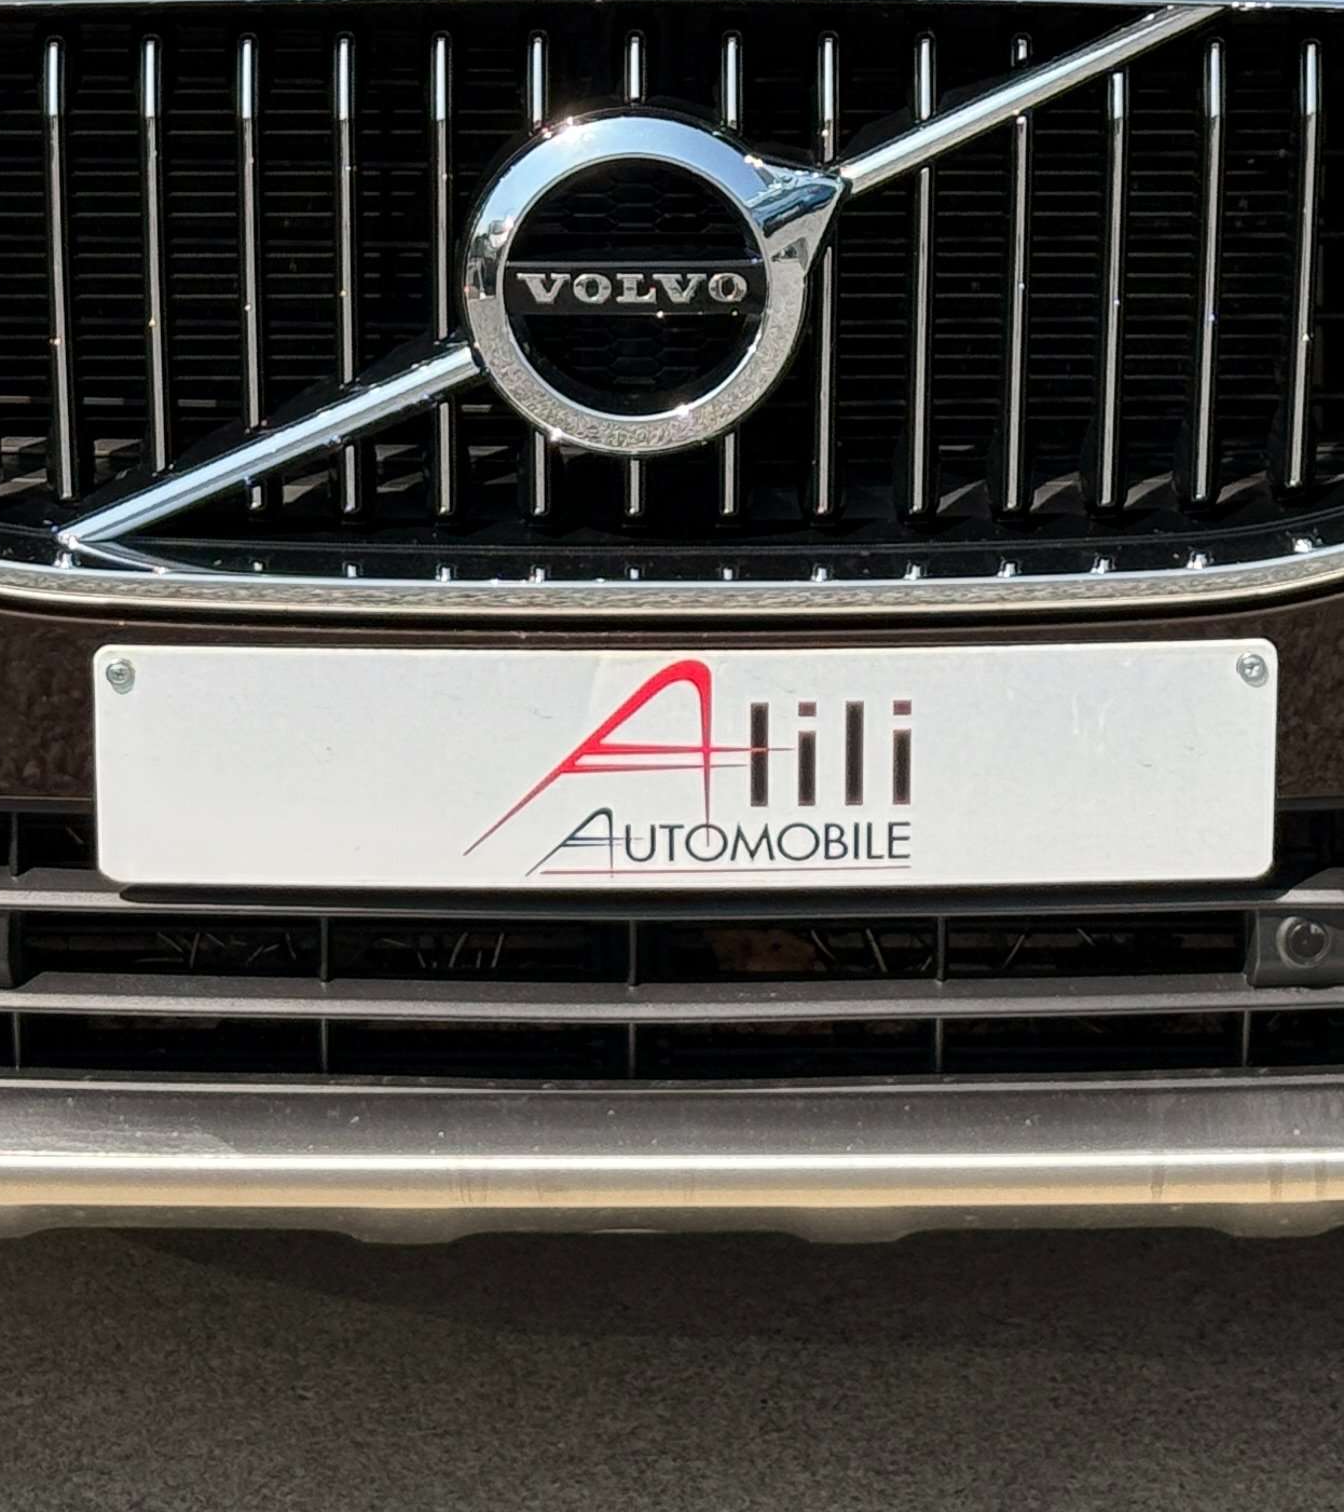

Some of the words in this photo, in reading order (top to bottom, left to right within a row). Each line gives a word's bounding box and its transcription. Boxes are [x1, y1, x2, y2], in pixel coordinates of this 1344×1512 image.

[516, 272, 748, 304] VOLVO
[462, 658, 912, 857] Alili
[525, 806, 912, 878] AUTOMOBILE
